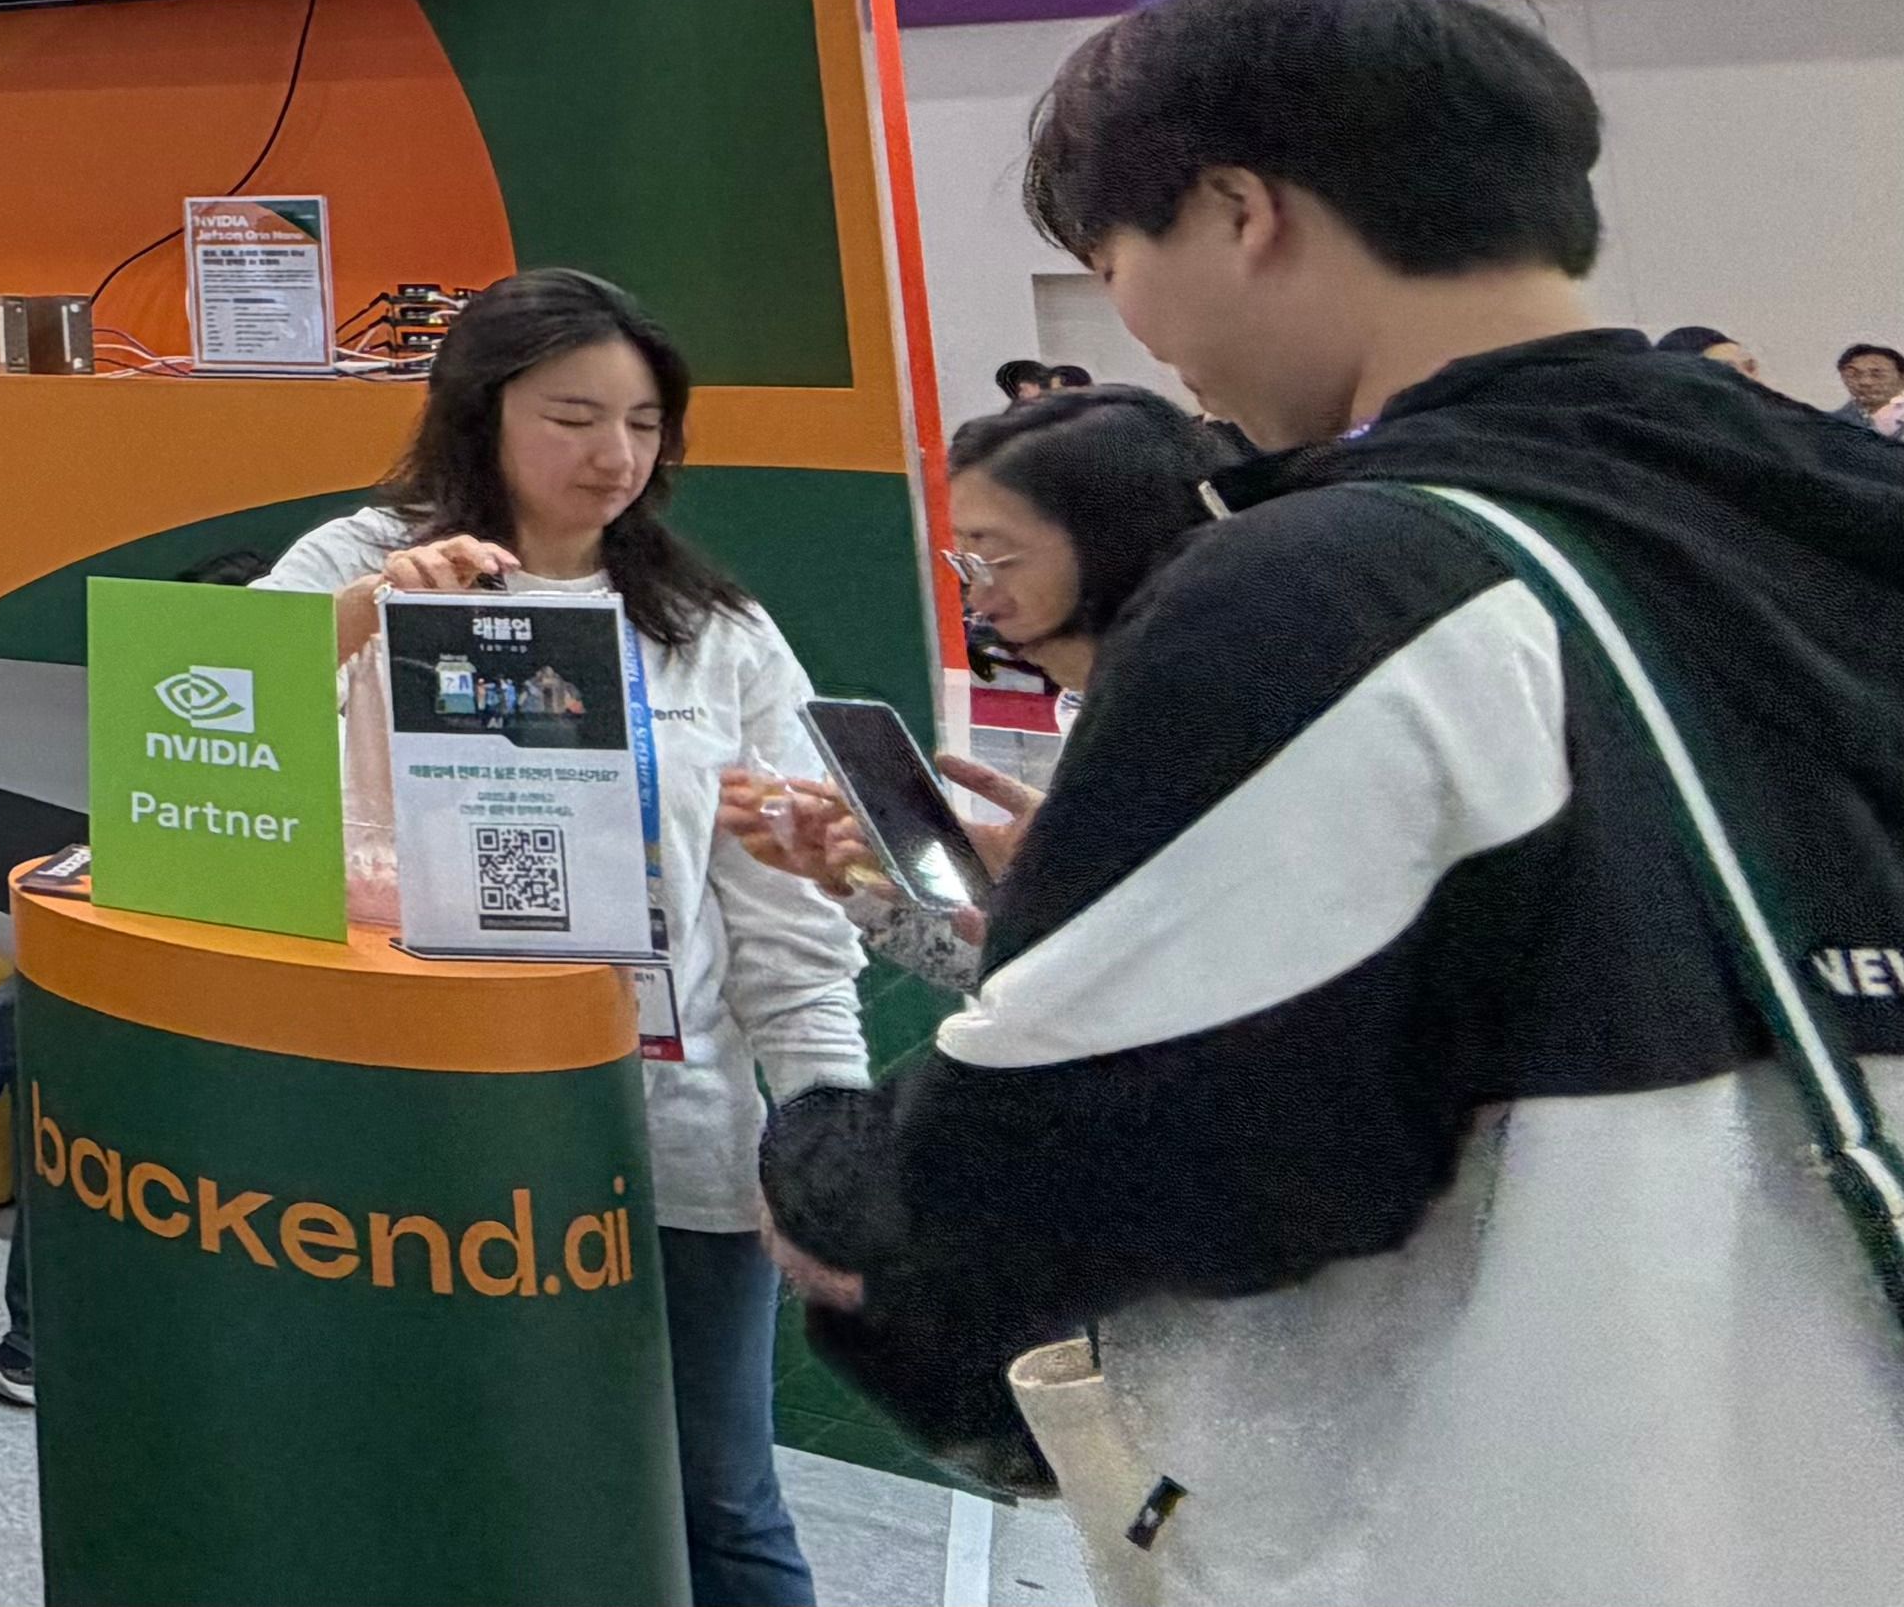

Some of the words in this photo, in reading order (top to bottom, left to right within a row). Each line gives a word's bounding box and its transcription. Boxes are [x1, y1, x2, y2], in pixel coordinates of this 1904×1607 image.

[472, 616, 533, 640] 래블업
[130, 790, 300, 843] Partner
[31, 1081, 634, 1298] backend.ai
